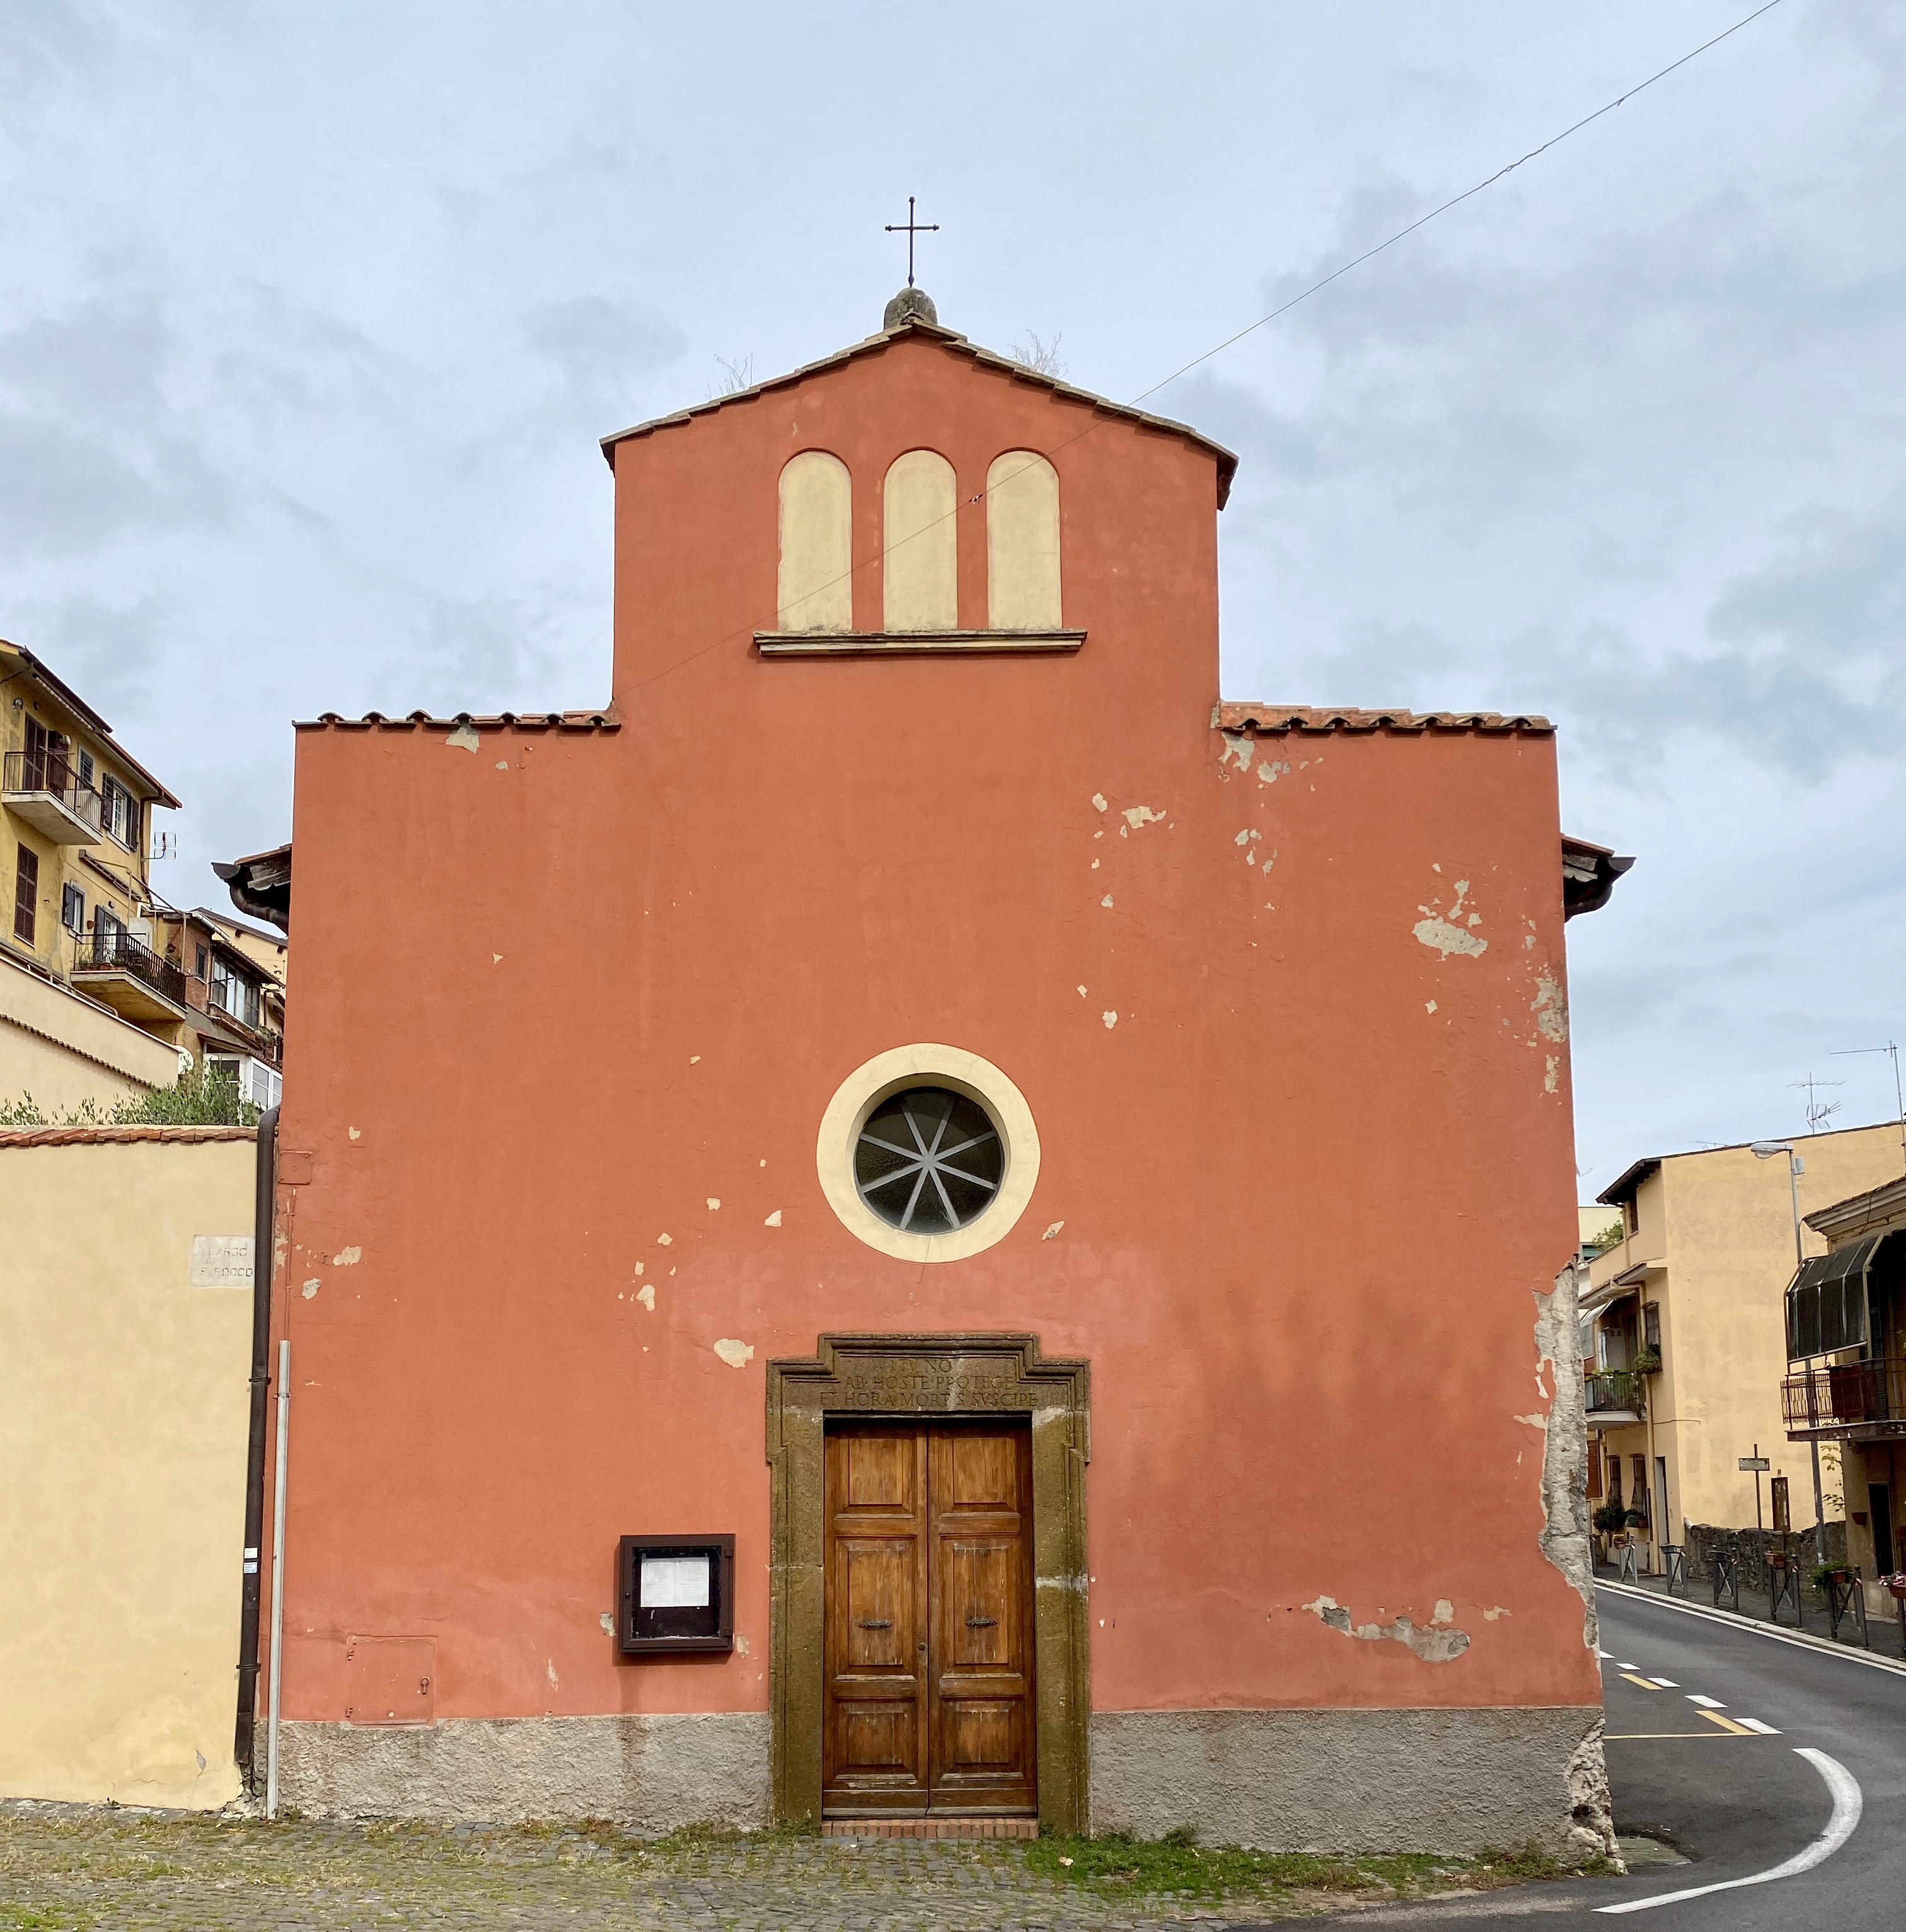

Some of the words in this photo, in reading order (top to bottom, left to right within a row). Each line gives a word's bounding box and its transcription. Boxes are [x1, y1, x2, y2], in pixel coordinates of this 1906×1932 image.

[207, 1246, 248, 1257] LARGO
[872, 1374, 930, 1390] HOSTE
[935, 1374, 1014, 1390] PROTEGE
[819, 1391, 838, 1406] ET
[844, 1392, 896, 1407] HORA
[898, 1392, 965, 1407] MORTS
[969, 1392, 1039, 1407] SVSCIPE
